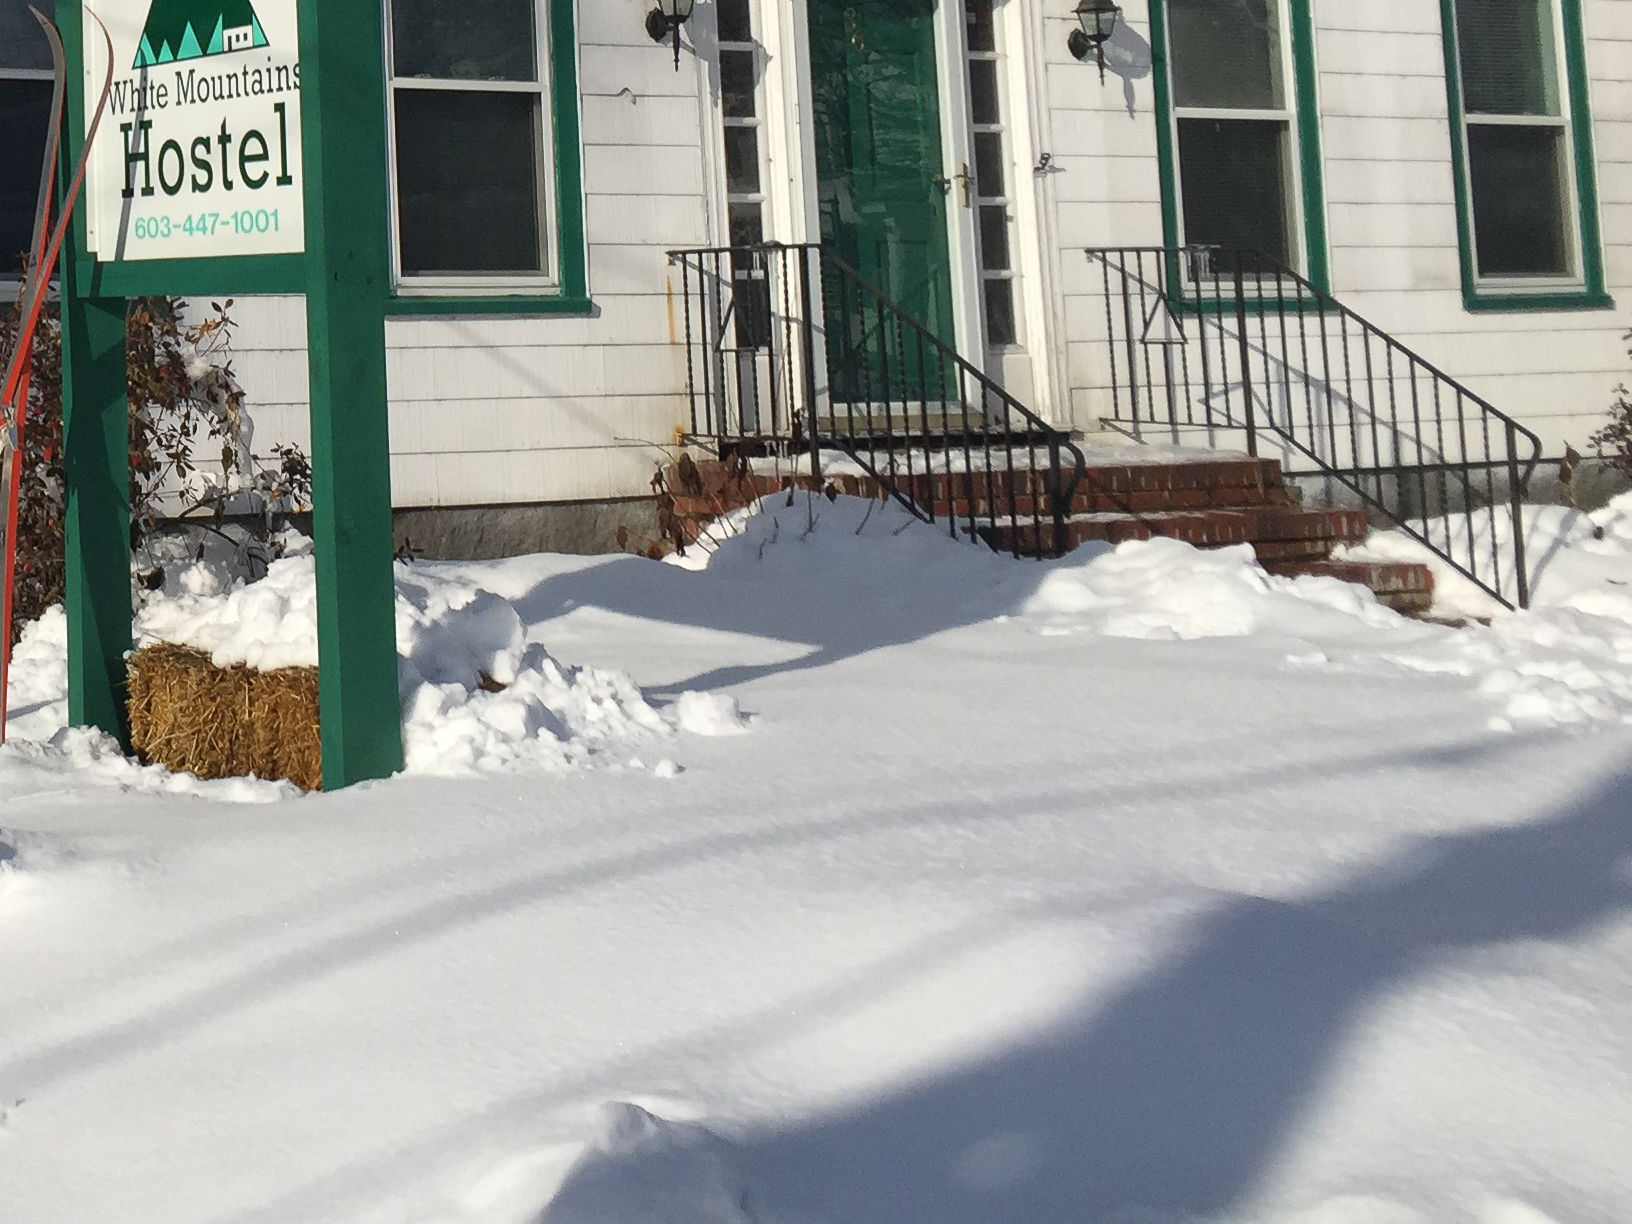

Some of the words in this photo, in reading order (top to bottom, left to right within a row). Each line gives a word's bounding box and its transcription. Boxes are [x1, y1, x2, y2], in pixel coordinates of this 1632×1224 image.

[109, 77, 168, 116] White
[174, 57, 301, 107] Mountains
[120, 103, 293, 199] Hostel
[134, 208, 281, 240] 603-447-1001
